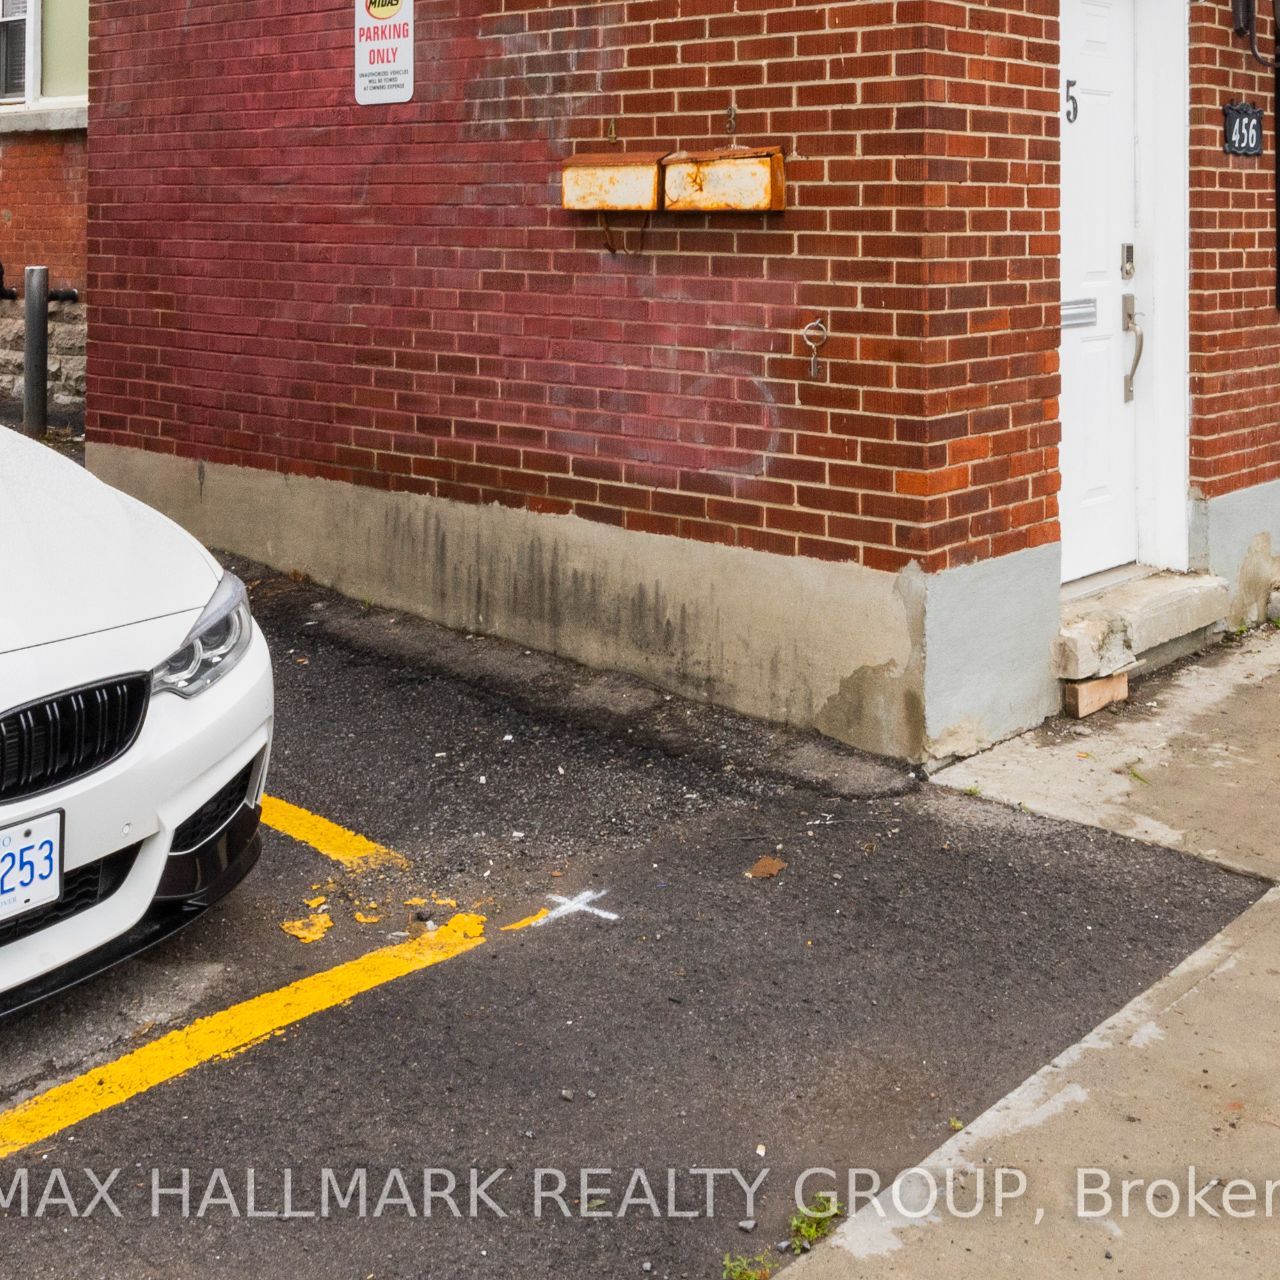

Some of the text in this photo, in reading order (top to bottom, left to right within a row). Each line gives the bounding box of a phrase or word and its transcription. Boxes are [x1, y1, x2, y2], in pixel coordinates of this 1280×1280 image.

[359, 23, 409, 42] PARKING
[369, 47, 398, 65] ONLY
[1066, 80, 1078, 124] 5
[607, 118, 617, 144] 4
[725, 106, 736, 133] 3
[1231, 117, 1257, 148] 456
[0, 839, 54, 897] 253
